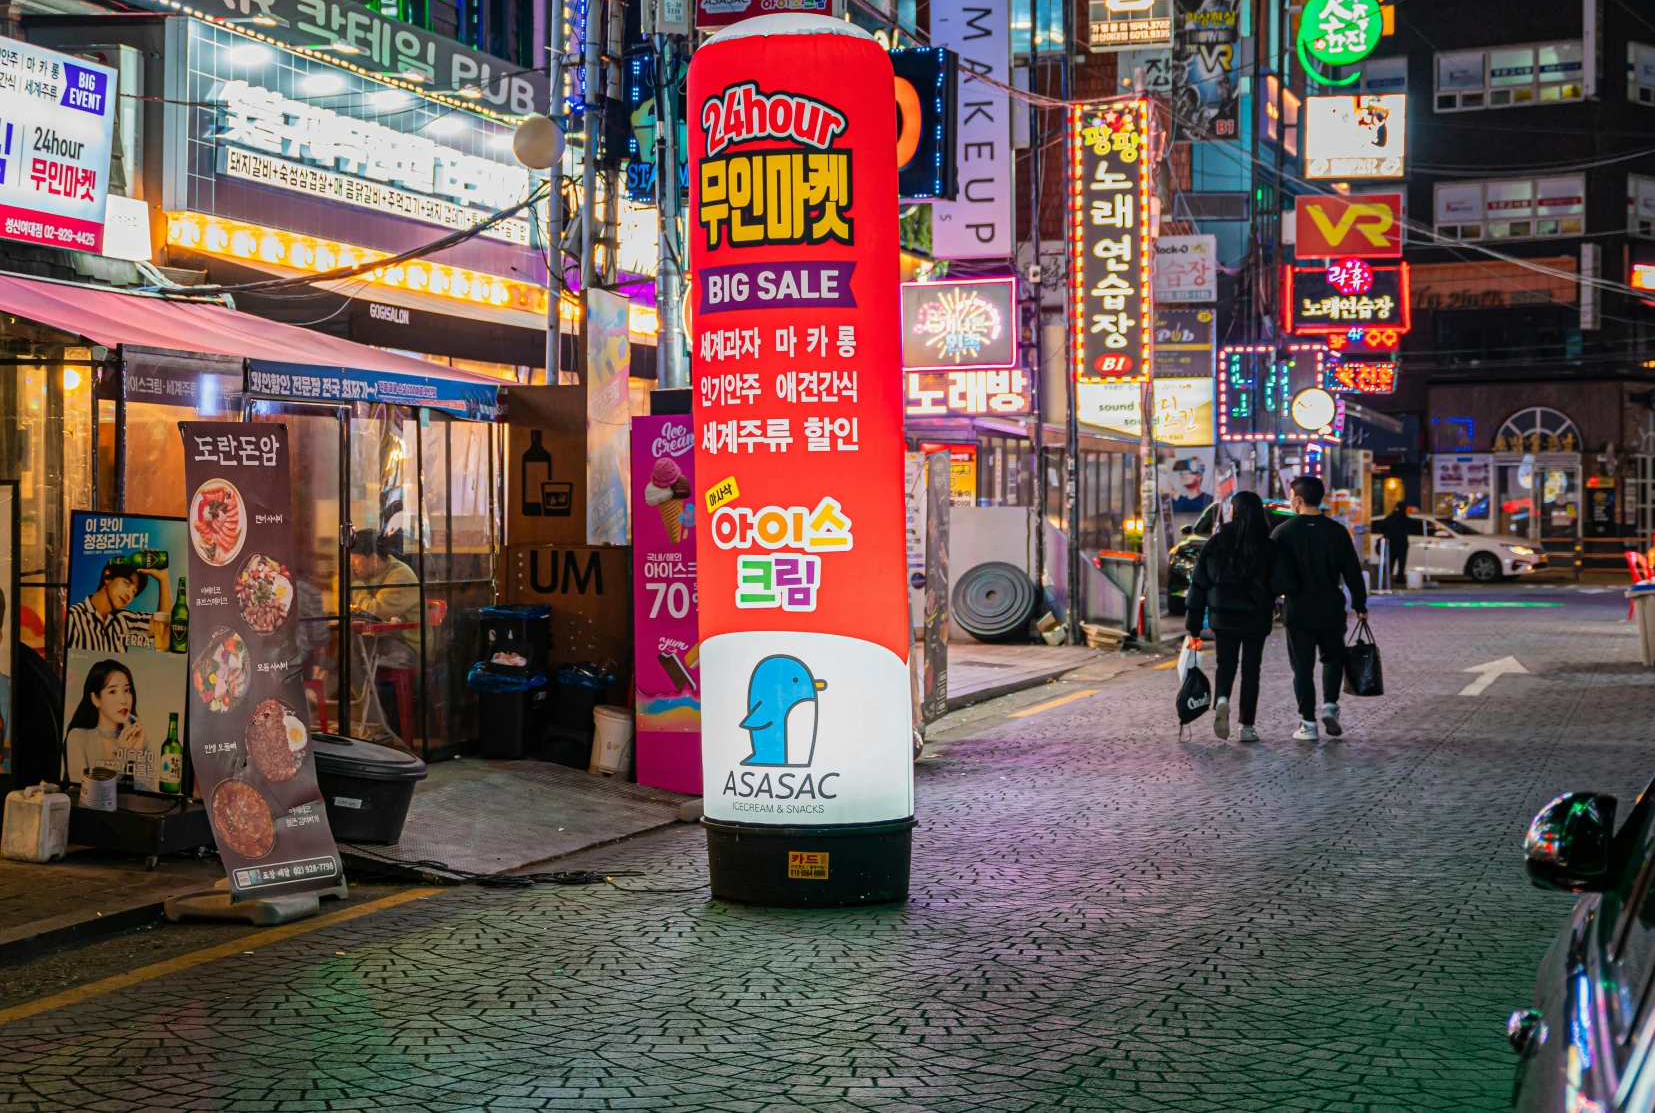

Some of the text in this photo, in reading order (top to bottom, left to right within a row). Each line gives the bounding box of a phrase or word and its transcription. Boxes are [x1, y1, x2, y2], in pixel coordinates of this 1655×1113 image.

[1185, 10, 1236, 26] 가상현실
[1200, 44, 1234, 75] VR
[79, 71, 96, 91] BIG
[452, 53, 536, 116] PUB
[69, 87, 101, 110] EVENT
[703, 84, 845, 158] 24hour
[1216, 119, 1234, 135] B1
[33, 126, 84, 160] 24hour
[30, 158, 97, 203] 무인마켓
[700, 153, 850, 246] 무인마켓
[5, 217, 95, 247] 성신여대점 02-929-4425
[1305, 203, 1394, 247] VR
[708, 270, 840, 305] BIG SALE
[370, 303, 409, 325] GOGISALON
[1302, 296, 1394, 319] 노래연습장
[700, 327, 762, 363] 세계과자
[1101, 357, 1125, 372] B1
[291, 376, 321, 397] 전문점
[322, 379, 341, 395] 전국
[700, 370, 858, 408] 인기안주 애견간식
[906, 370, 1028, 414] 노래방
[1099, 402, 1134, 411] sound
[662, 422, 686, 439] Ice
[702, 417, 859, 455] 세계주류 할인
[194, 435, 280, 466] 도란돈암
[86, 518, 123, 533] 이 맛이
[715, 503, 848, 547] 아이스
[83, 533, 149, 550] 청정라거다!
[647, 553, 682, 562] 국내/해외
[530, 550, 603, 596] UM
[740, 559, 815, 606] 크림
[118, 634, 151, 648] TERRA
[722, 769, 840, 801] ASASAC
[732, 802, 825, 814] ICECREAM & SNACKS
[305, 862, 334, 874] 928-7798
